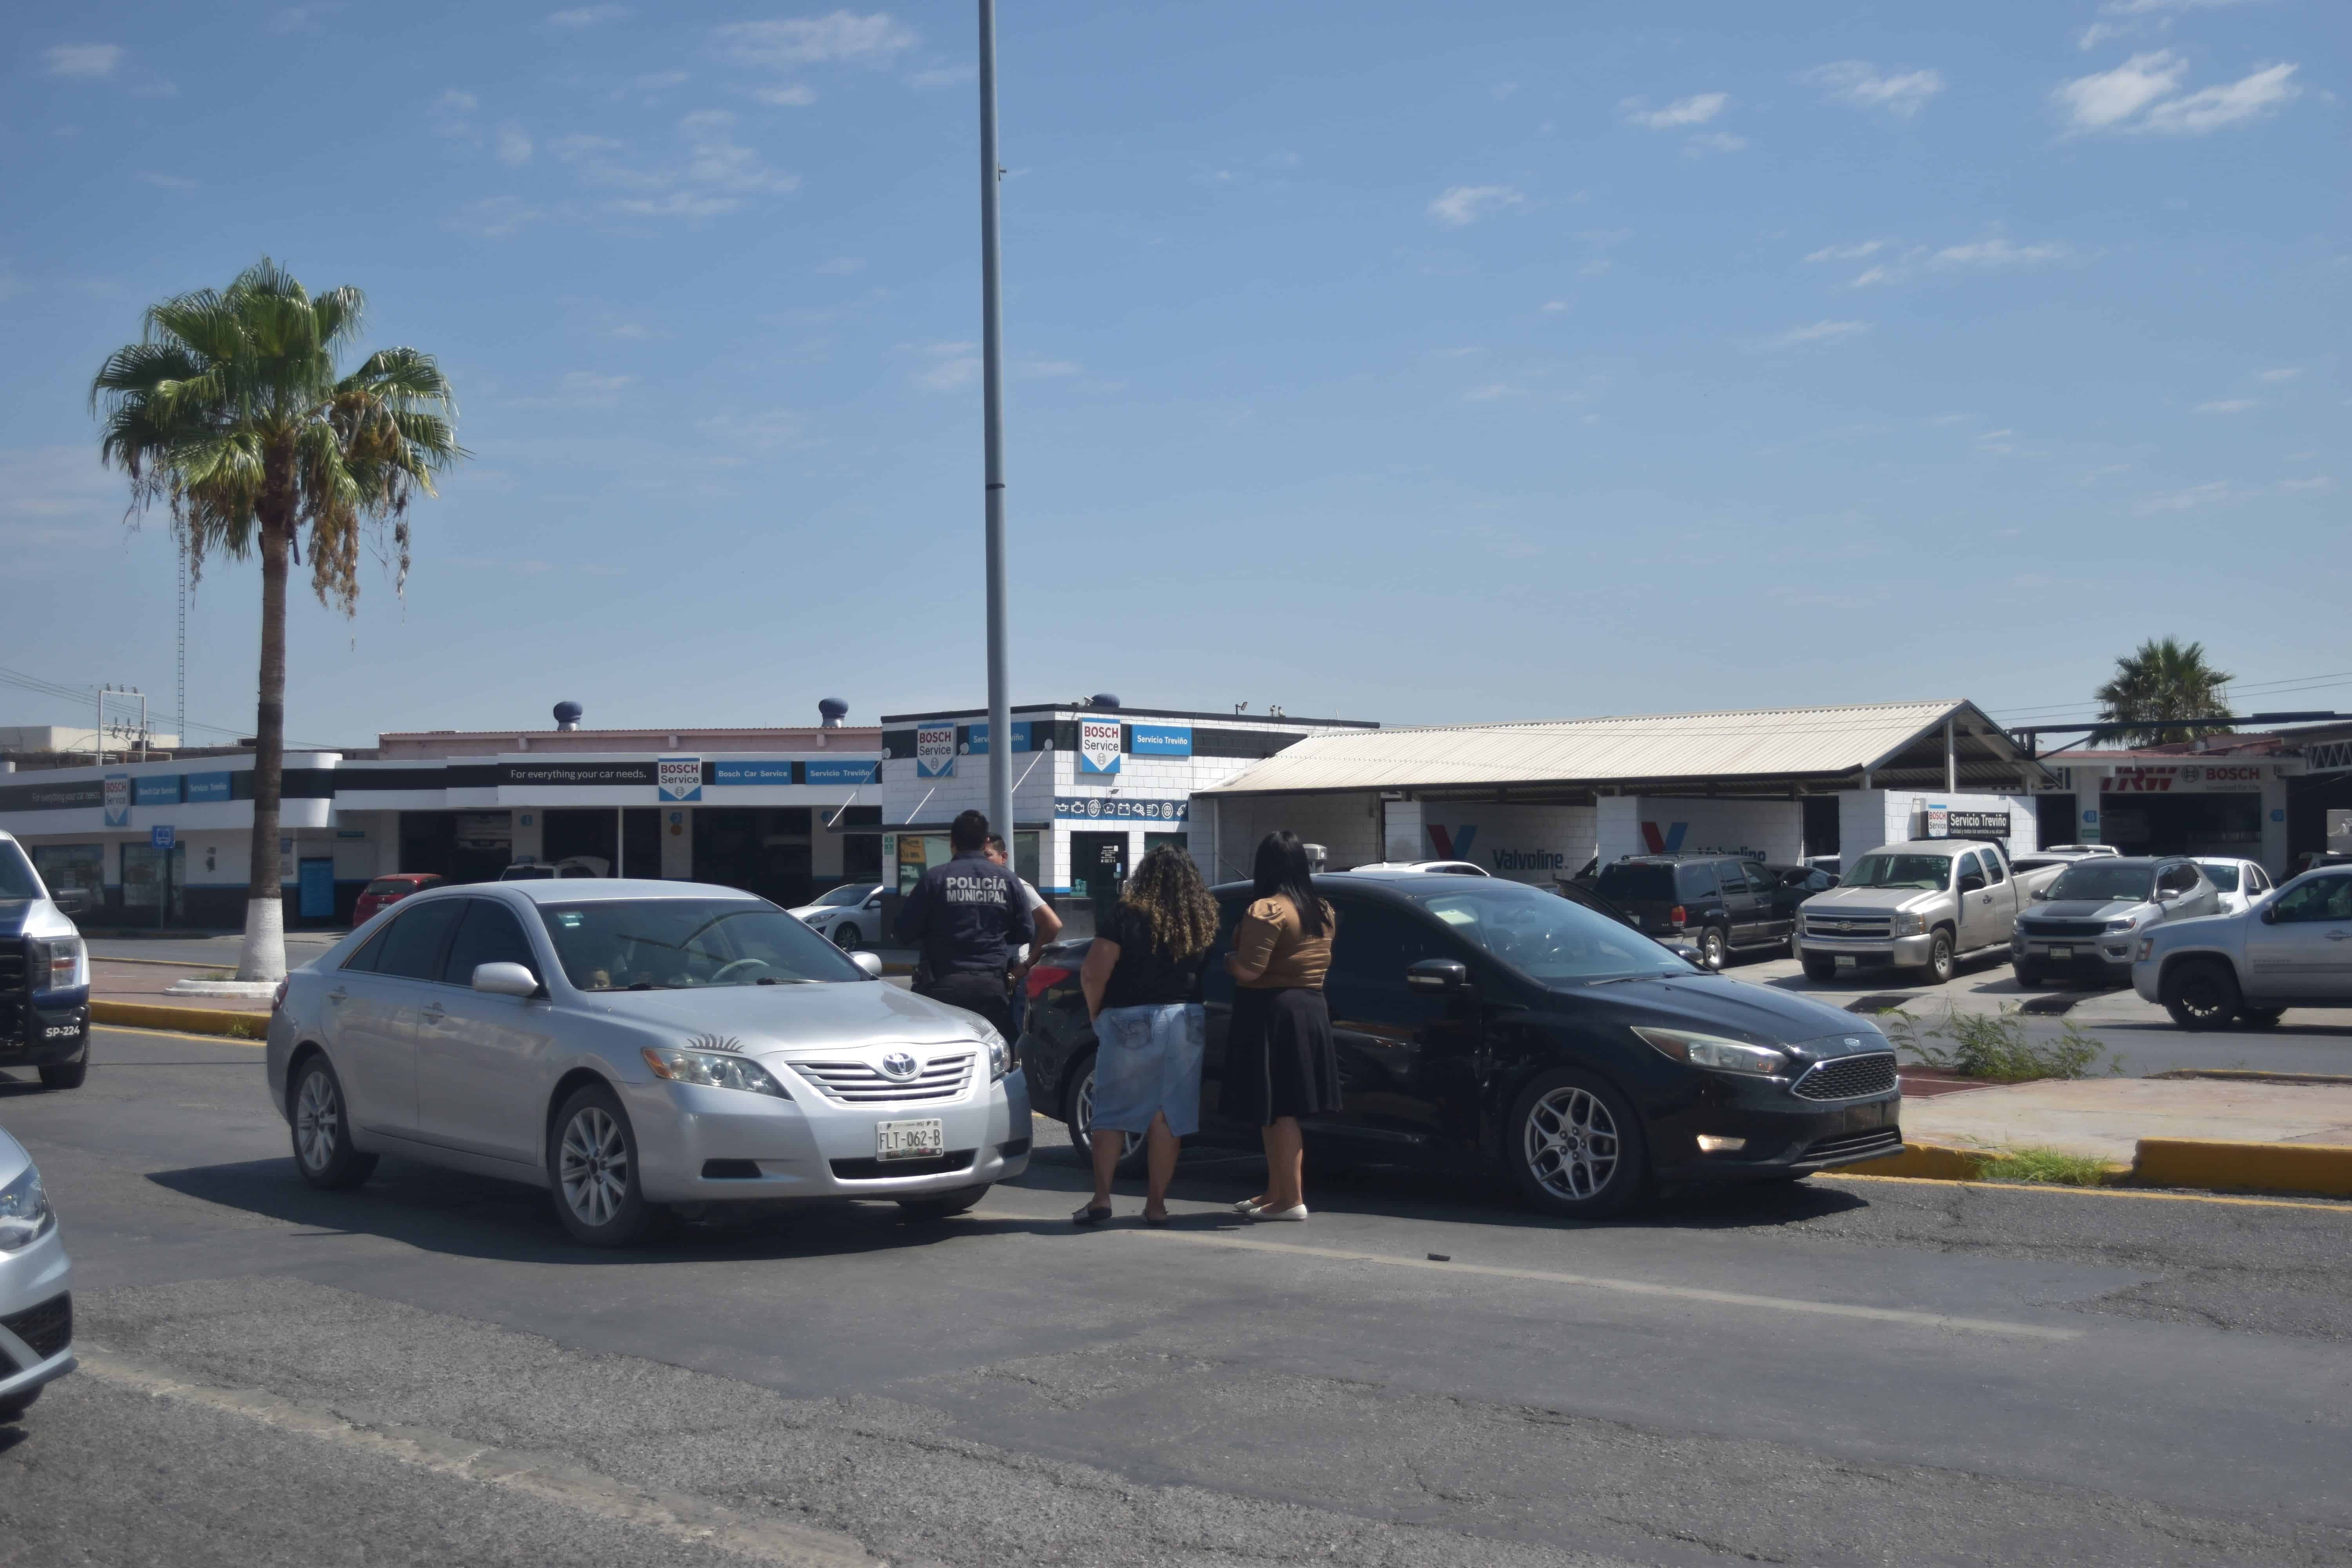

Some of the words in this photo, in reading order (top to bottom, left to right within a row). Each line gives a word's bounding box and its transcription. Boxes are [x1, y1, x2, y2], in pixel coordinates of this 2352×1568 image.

[920, 731, 951, 743] BOSCH
[1085, 726, 1118, 738] BOSCH
[1084, 740, 1118, 751] Service
[1137, 735, 1163, 744] Servicio
[920, 744, 951, 756] Service
[511, 769, 526, 778] For
[528, 769, 575, 780] everything
[577, 771, 597, 780] your
[616, 769, 646, 778] needs.
[661, 765, 698, 773] BOSCH
[2206, 768, 2259, 780] BOSCH
[661, 775, 699, 784] Service
[2101, 767, 2177, 791] TRW
[106, 781, 126, 793] BOSCH
[106, 795, 126, 805] Service
[1929, 812, 1946, 820] BOSCH
[1950, 813, 1979, 827] Servicio
[1981, 814, 2007, 827] Treviño
[1493, 849, 1563, 870] Valvoline
[947, 876, 1007, 890] POLICÍA
[947, 889, 1006, 903] MUNICIPAL
[46, 1025, 80, 1037] SP-224
[880, 1129, 940, 1149] FLT-062-B
